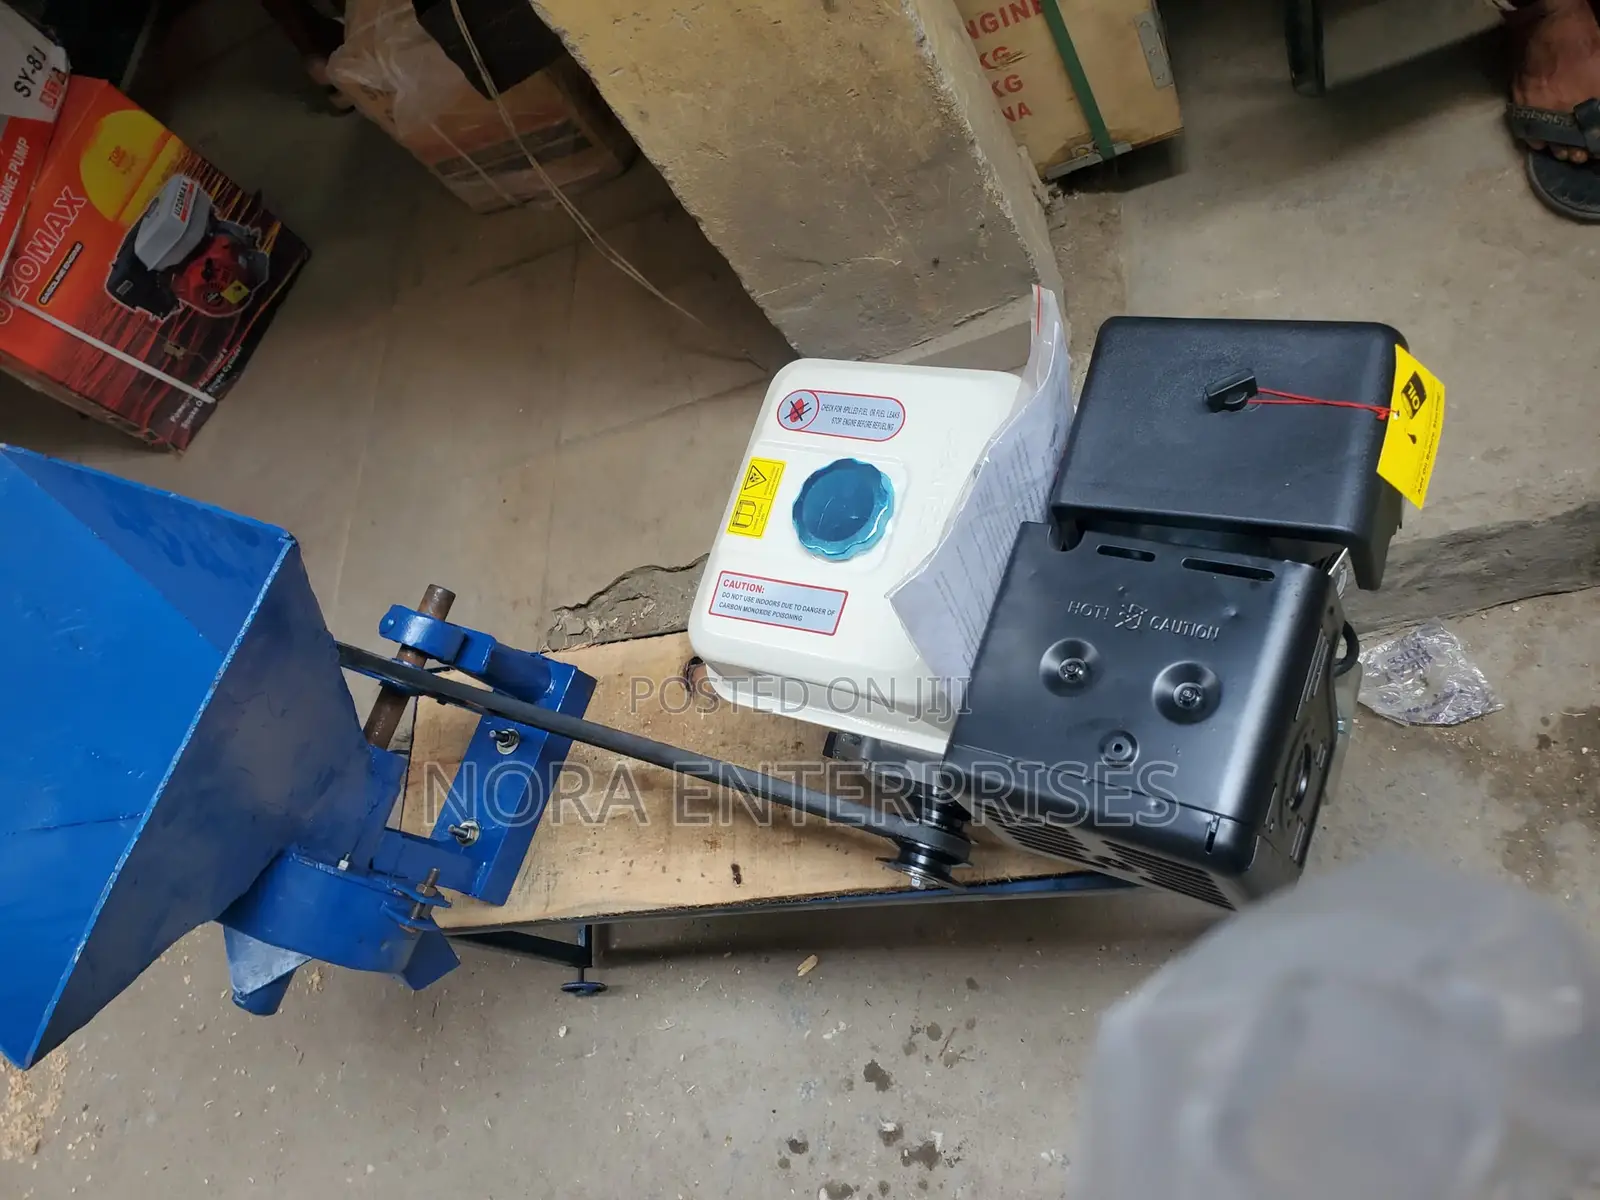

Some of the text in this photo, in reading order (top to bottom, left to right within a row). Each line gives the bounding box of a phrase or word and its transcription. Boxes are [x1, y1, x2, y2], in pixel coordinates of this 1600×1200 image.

[8, 136, 30, 175] PUMP
[1408, 381, 1420, 410] OIL
[821, 403, 834, 412] CHECK
[833, 405, 843, 413] FOR
[843, 406, 859, 415] SPILLED
[858, 408, 868, 416] FUEL
[875, 409, 886, 418] FUEL
[886, 411, 900, 419] LEAKS
[831, 416, 895, 431] STOP ENGINE BEFORE REFUELING
[723, 579, 765, 594] CAUTION:
[718, 601, 803, 622] CARBON MONOXIDE POISONING
[721, 591, 731, 599] DO
[731, 593, 743, 601] NOT
[743, 595, 755, 604] USE
[755, 598, 781, 608] INDOORS
[780, 601, 794, 610] DUE
[802, 605, 827, 616] DANGER
[827, 609, 836, 617] OF
[1067, 600, 1220, 641] HOT! CAUTION
